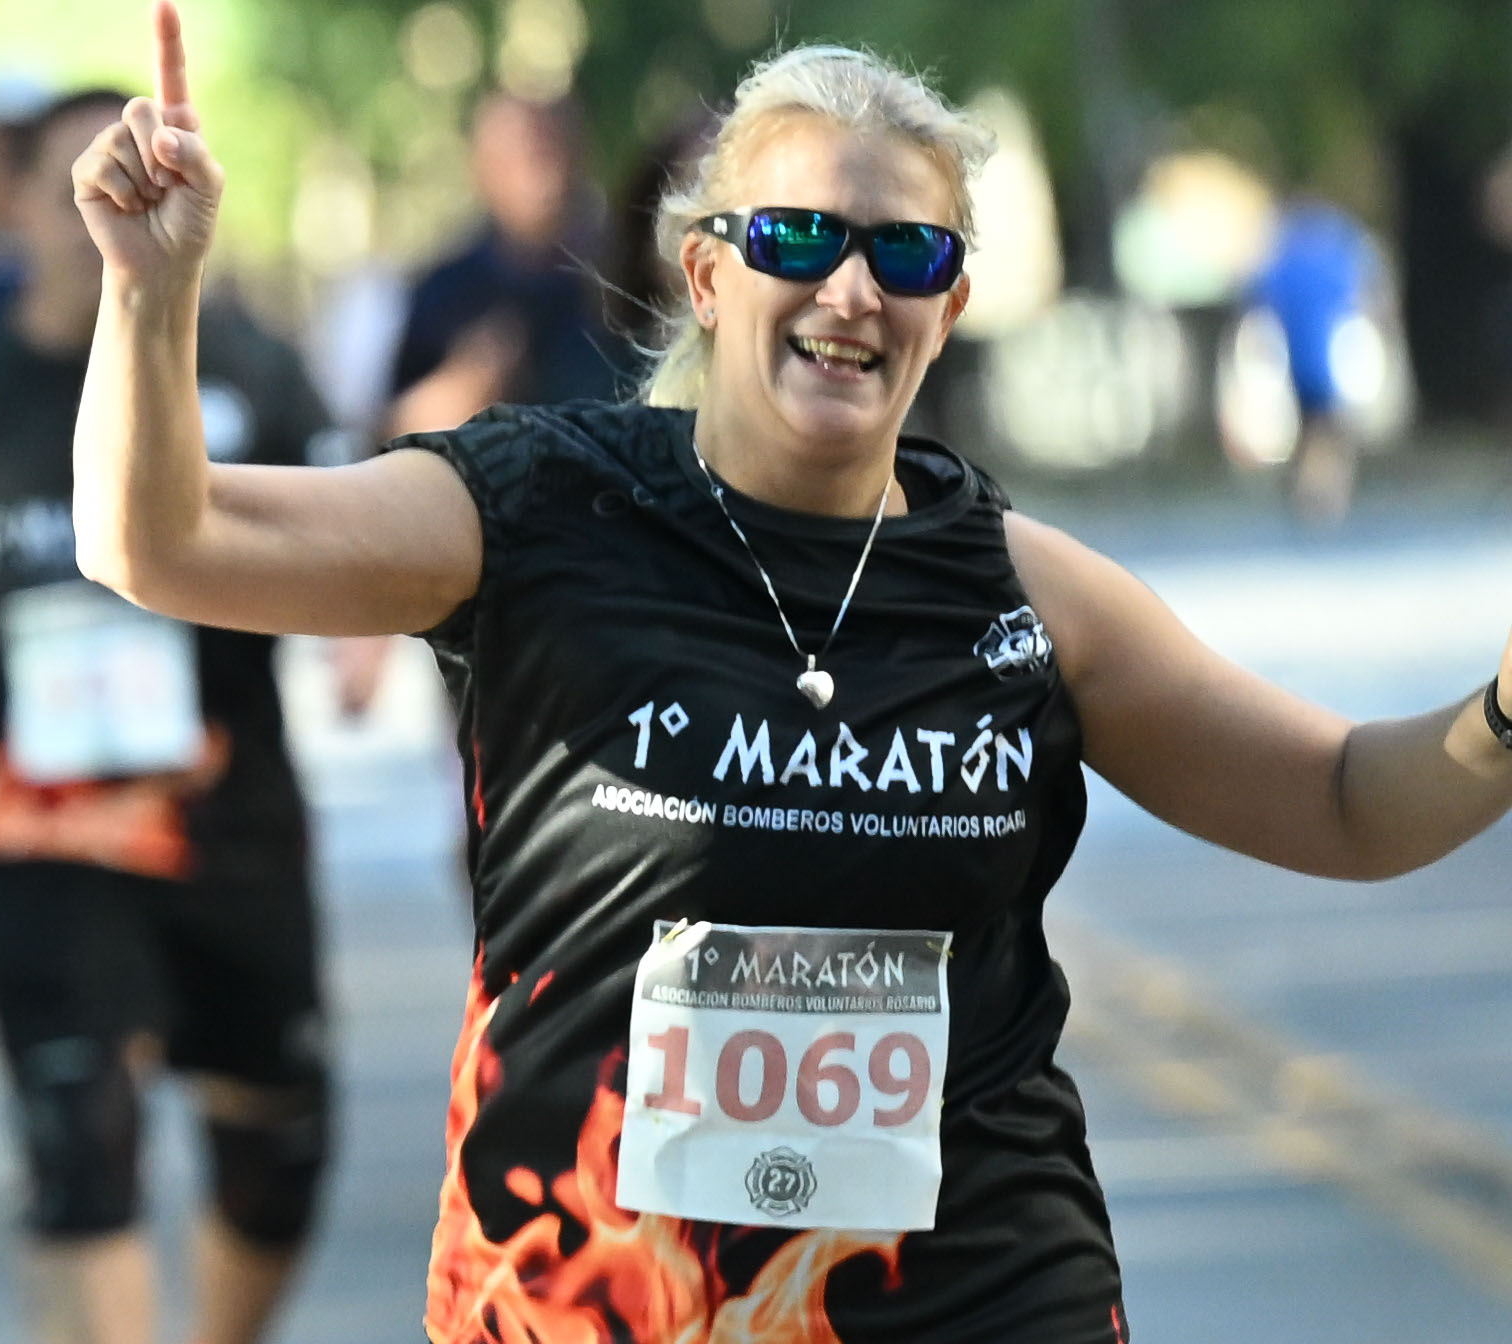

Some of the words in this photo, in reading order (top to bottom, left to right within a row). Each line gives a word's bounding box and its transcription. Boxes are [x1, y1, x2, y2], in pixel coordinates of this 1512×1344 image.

[713, 713, 1033, 794] MARATÓN
[592, 783, 717, 824] ASOCIACIÓN
[723, 804, 844, 834] BOMBEROS
[850, 811, 980, 839] VOLUNTARIOS
[730, 940, 906, 989] MARATÓN
[731, 992, 802, 1011] BOMBEROS
[886, 995, 936, 1012] ROSARIO
[644, 1026, 932, 1128] 1069
[768, 1167, 796, 1193] 27
